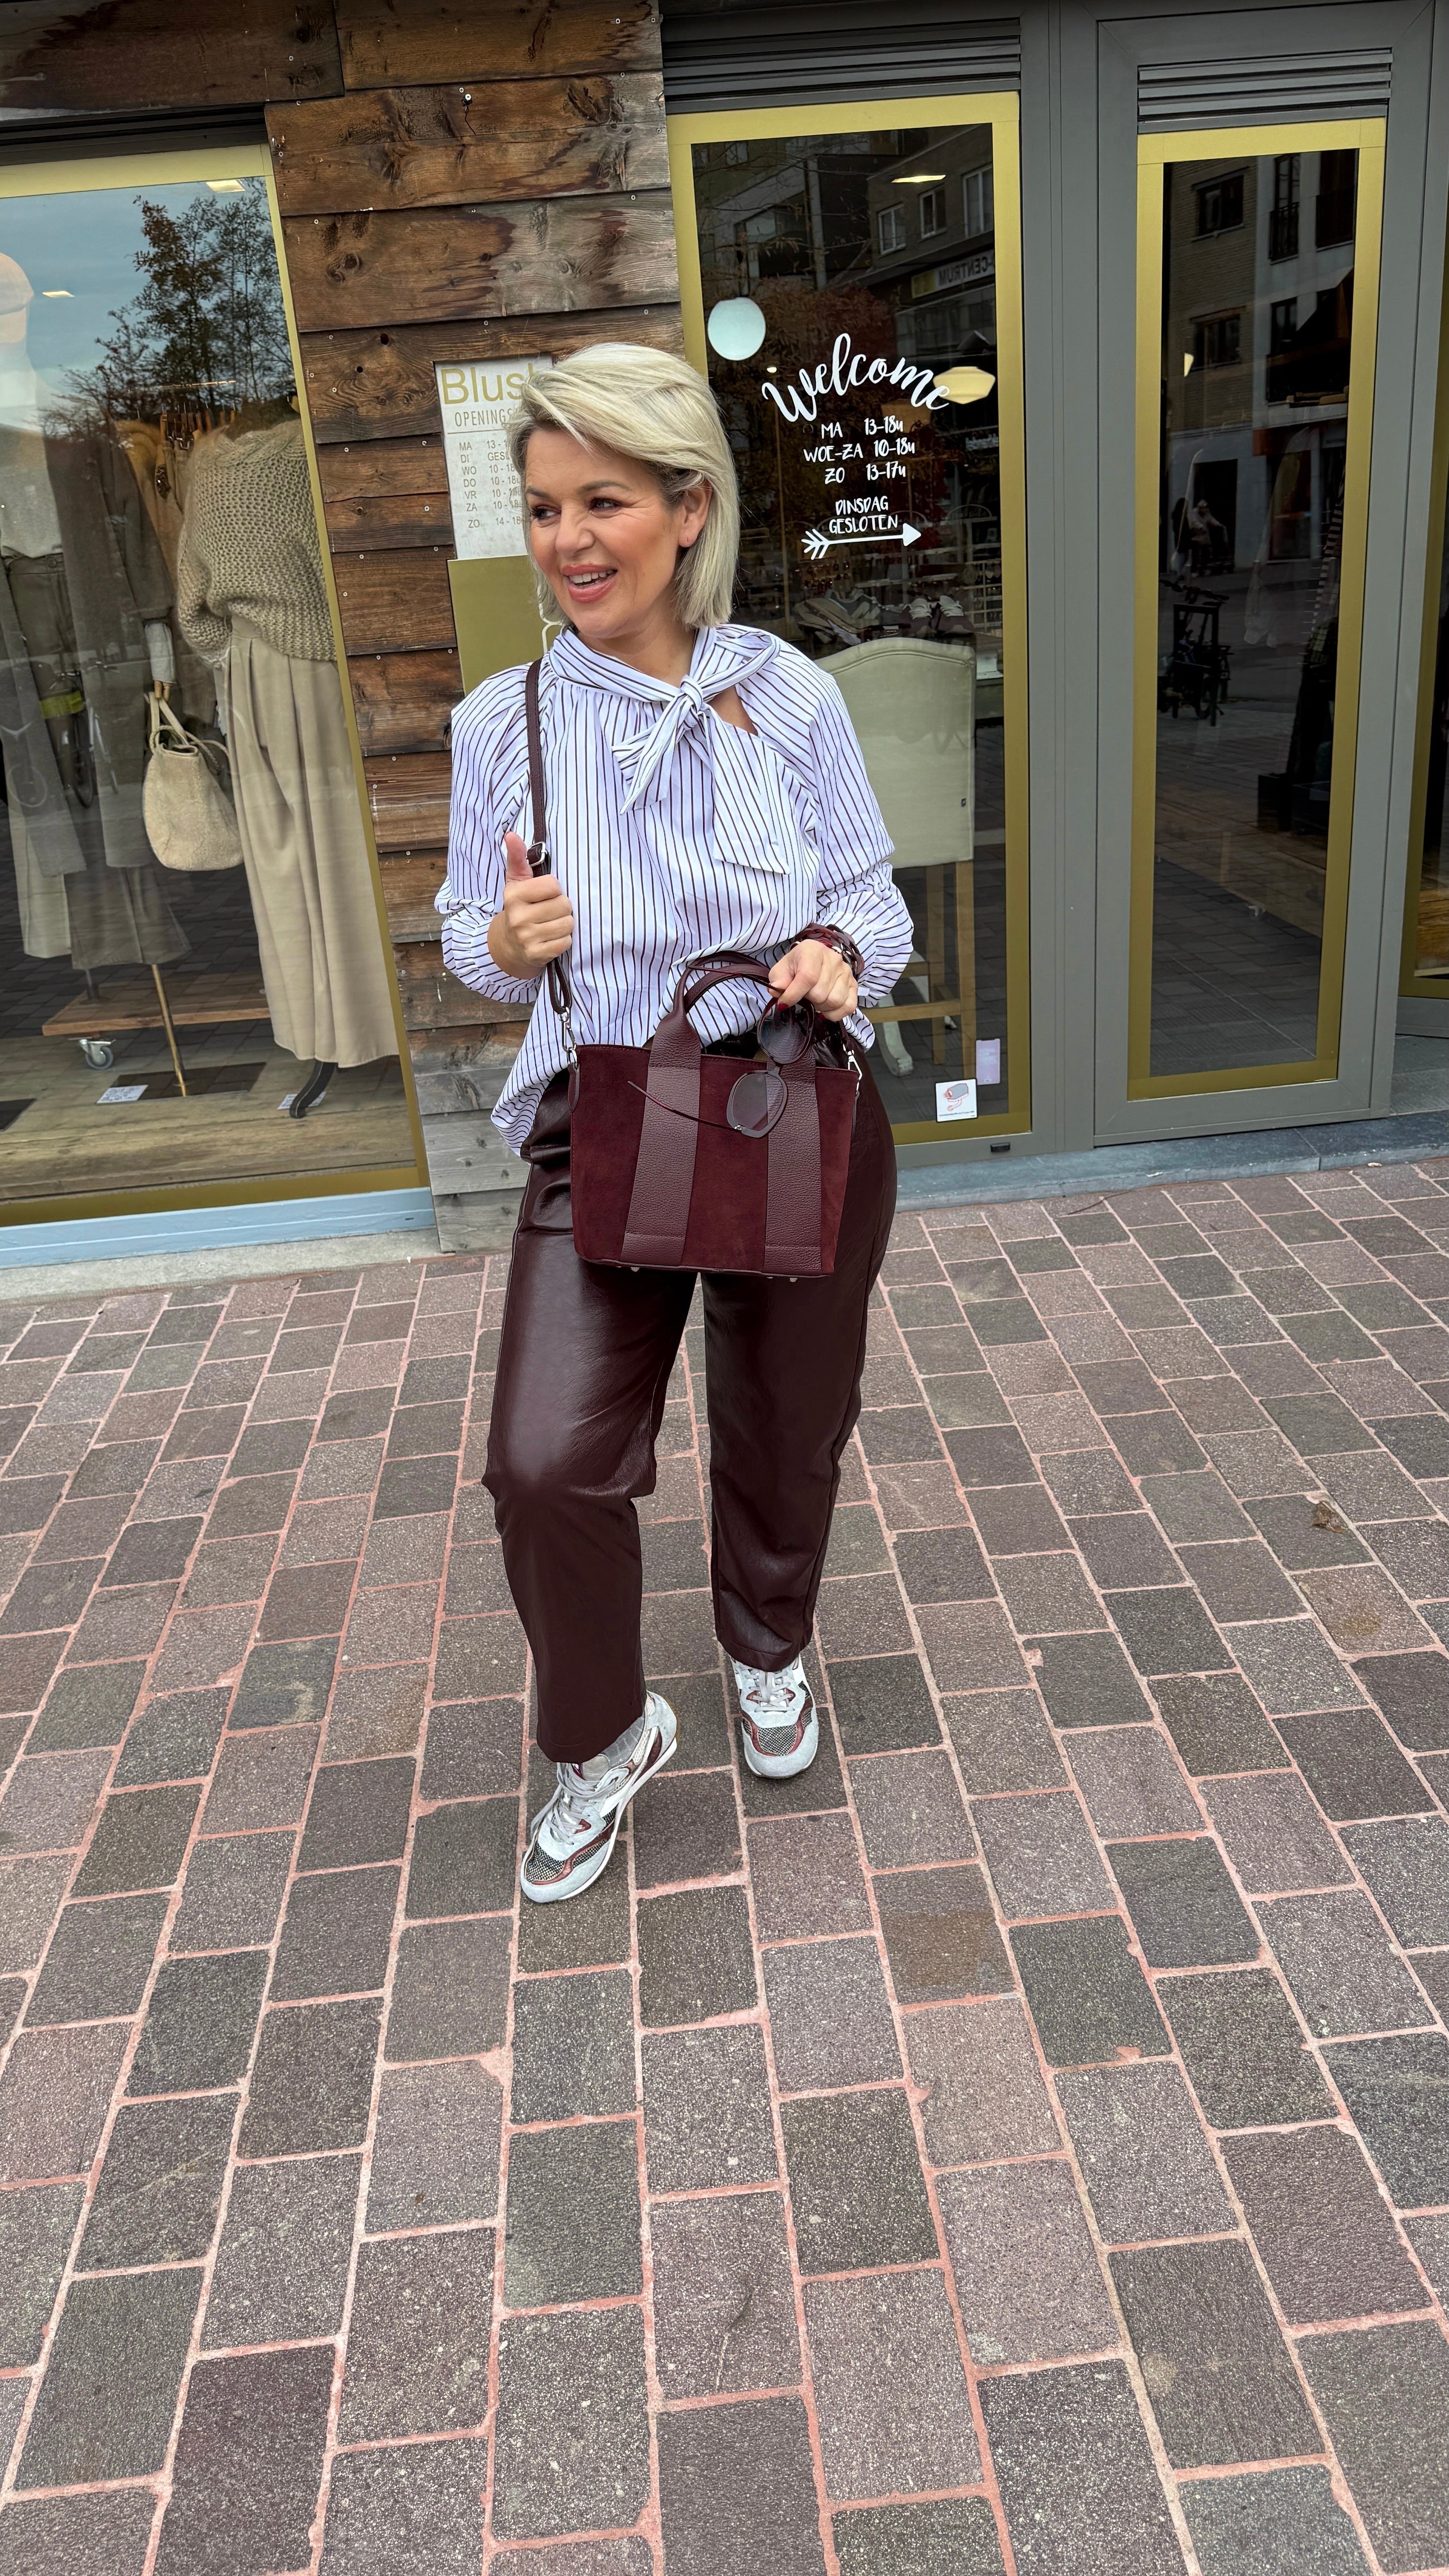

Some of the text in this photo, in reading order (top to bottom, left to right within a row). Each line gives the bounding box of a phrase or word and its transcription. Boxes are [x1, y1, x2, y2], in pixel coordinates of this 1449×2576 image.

[761, 333, 950, 422] Welcome
[821, 415, 903, 439] MA 13-18u
[459, 442, 473, 451] MA
[487, 440, 496, 449] 13
[803, 437, 915, 463] WOE-ZA 10-18u
[460, 455, 469, 463] DI
[462, 466, 477, 475] WO
[489, 465, 498, 473] 10
[825, 460, 906, 484] ZO 13-17u
[464, 478, 476, 488] DO
[491, 476, 500, 485] 10
[465, 491, 477, 499] VR
[492, 488, 501, 497] 10
[466, 503, 478, 511] ZA
[493, 501, 502, 509] 10
[835, 496, 888, 515] DINSDAG
[468, 520, 480, 528] ZO
[496, 517, 504, 525] 14
[829, 515, 898, 534] GESLOTEN
